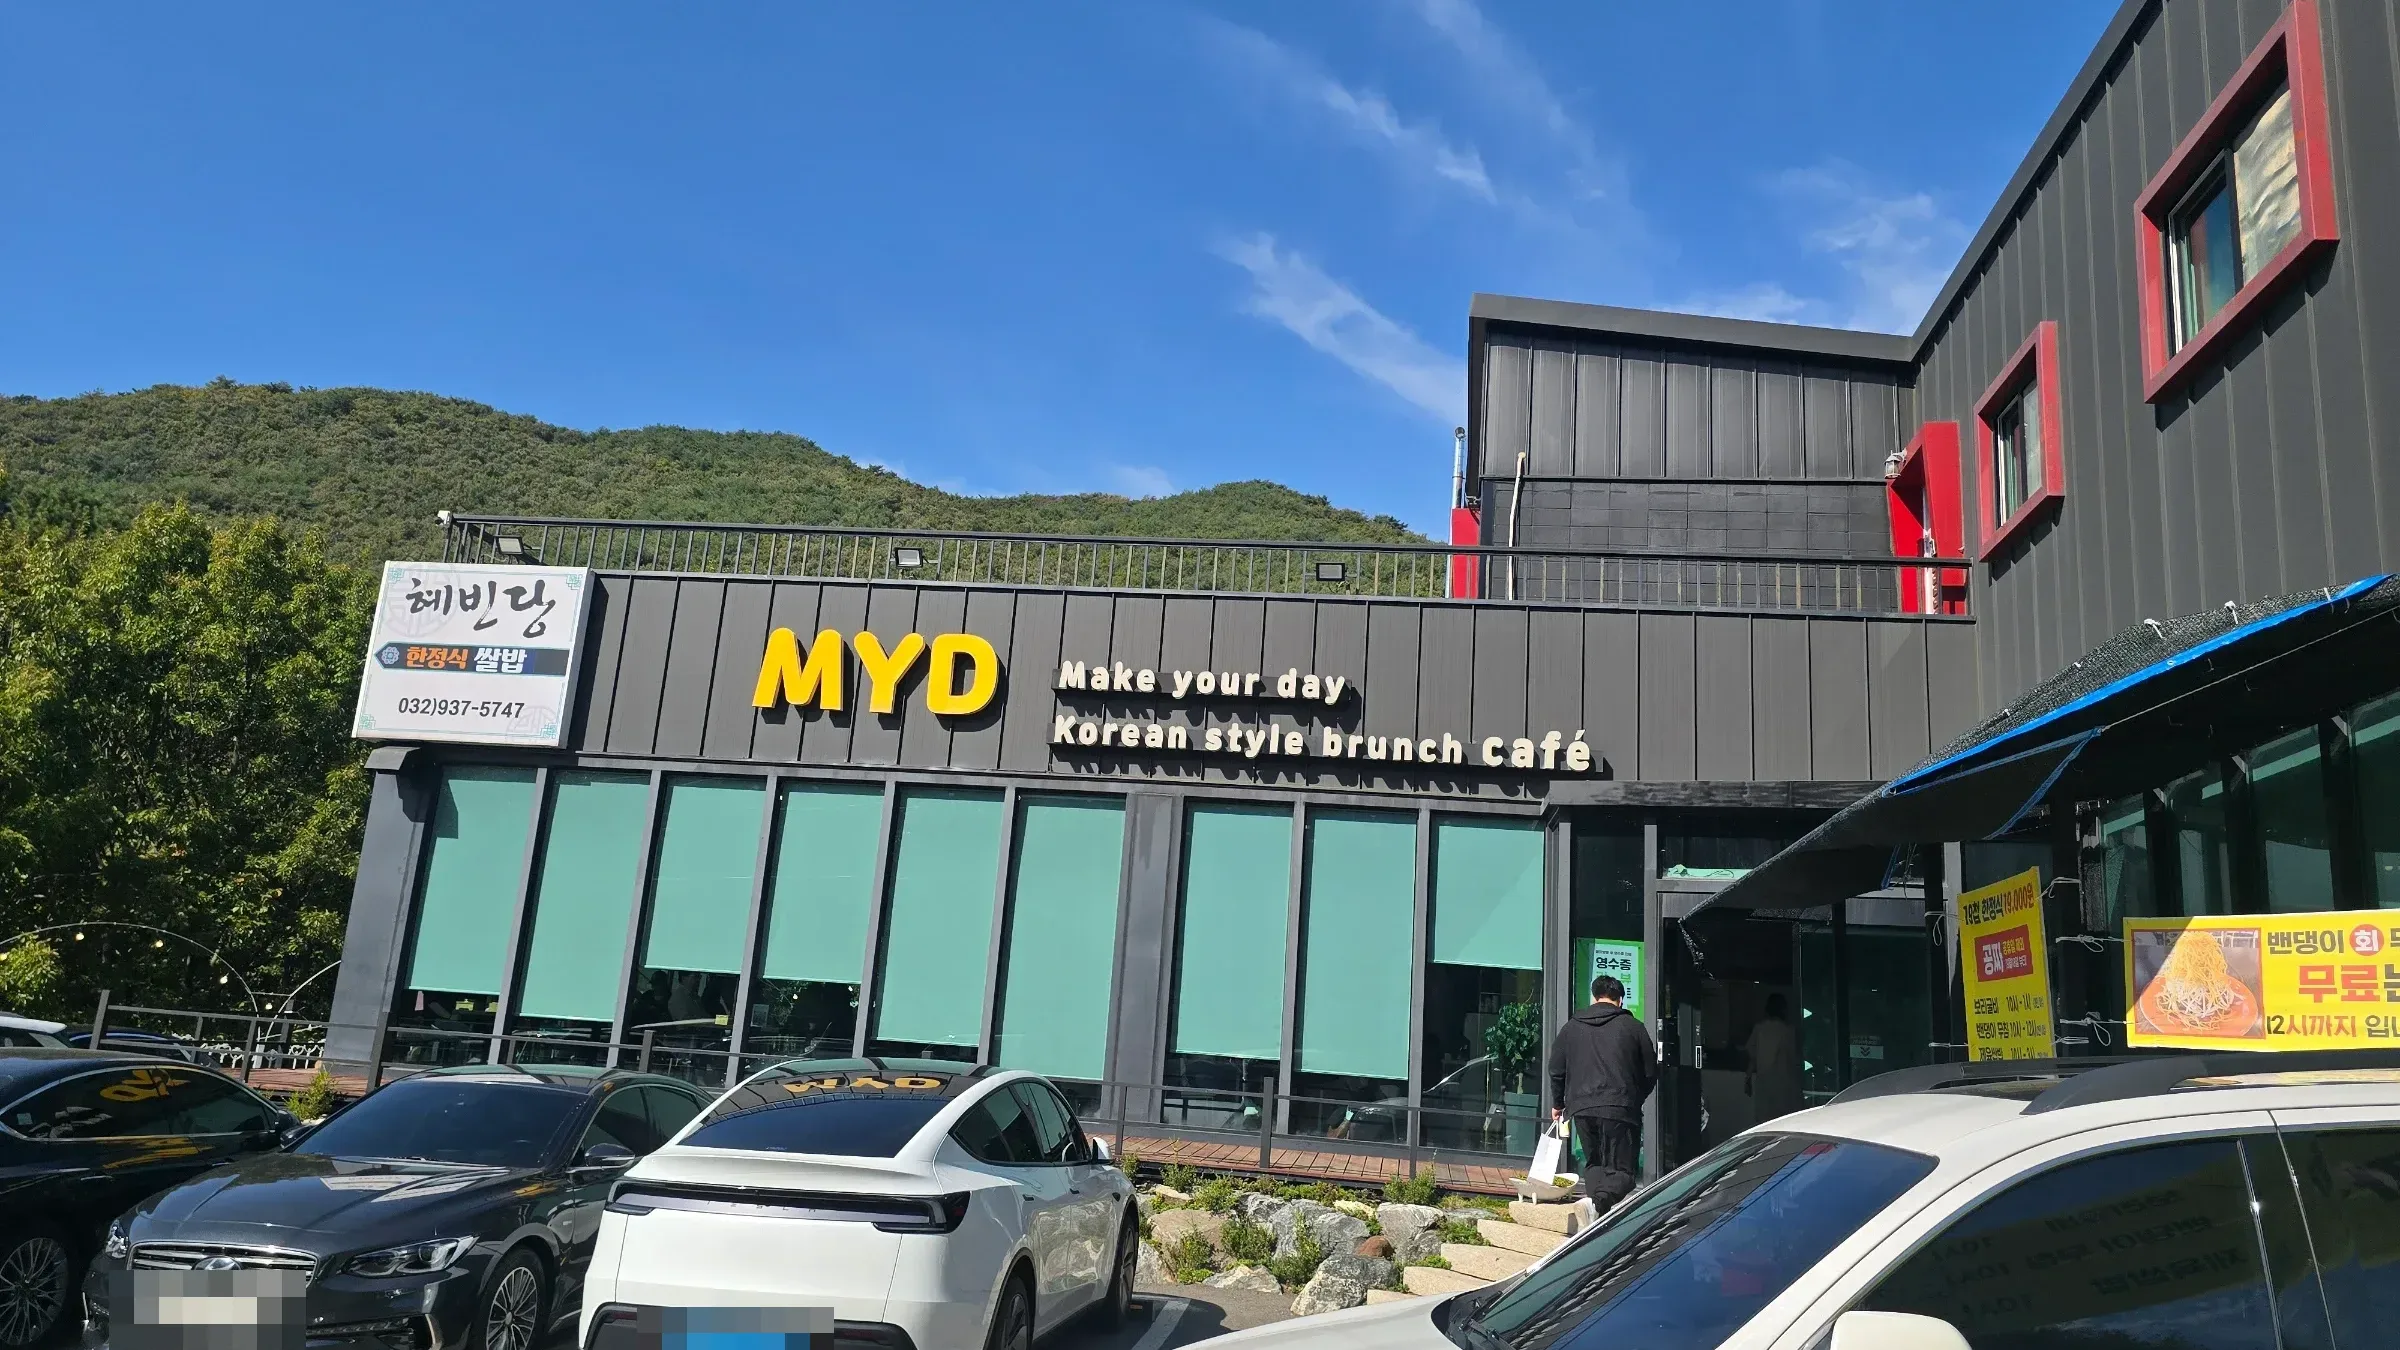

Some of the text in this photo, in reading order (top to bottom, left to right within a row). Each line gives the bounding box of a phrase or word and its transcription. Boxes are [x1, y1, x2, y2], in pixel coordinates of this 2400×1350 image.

[406, 578, 556, 638] 혜빈당
[406, 646, 528, 674] 한정식 쌀밥
[752, 627, 999, 715] MYD
[1058, 660, 1346, 705] Make your day
[398, 697, 525, 719] 032)937-5747
[1053, 715, 1590, 772] Korean style brunch café
[1981, 893, 2004, 922] 한정식
[2004, 882, 2034, 914] 19,000원
[2267, 929, 2344, 955] 밴댕이
[2354, 929, 2379, 951] 회
[1596, 956, 1632, 971] 영수증
[1976, 1021, 1996, 1039] 밴댕이
